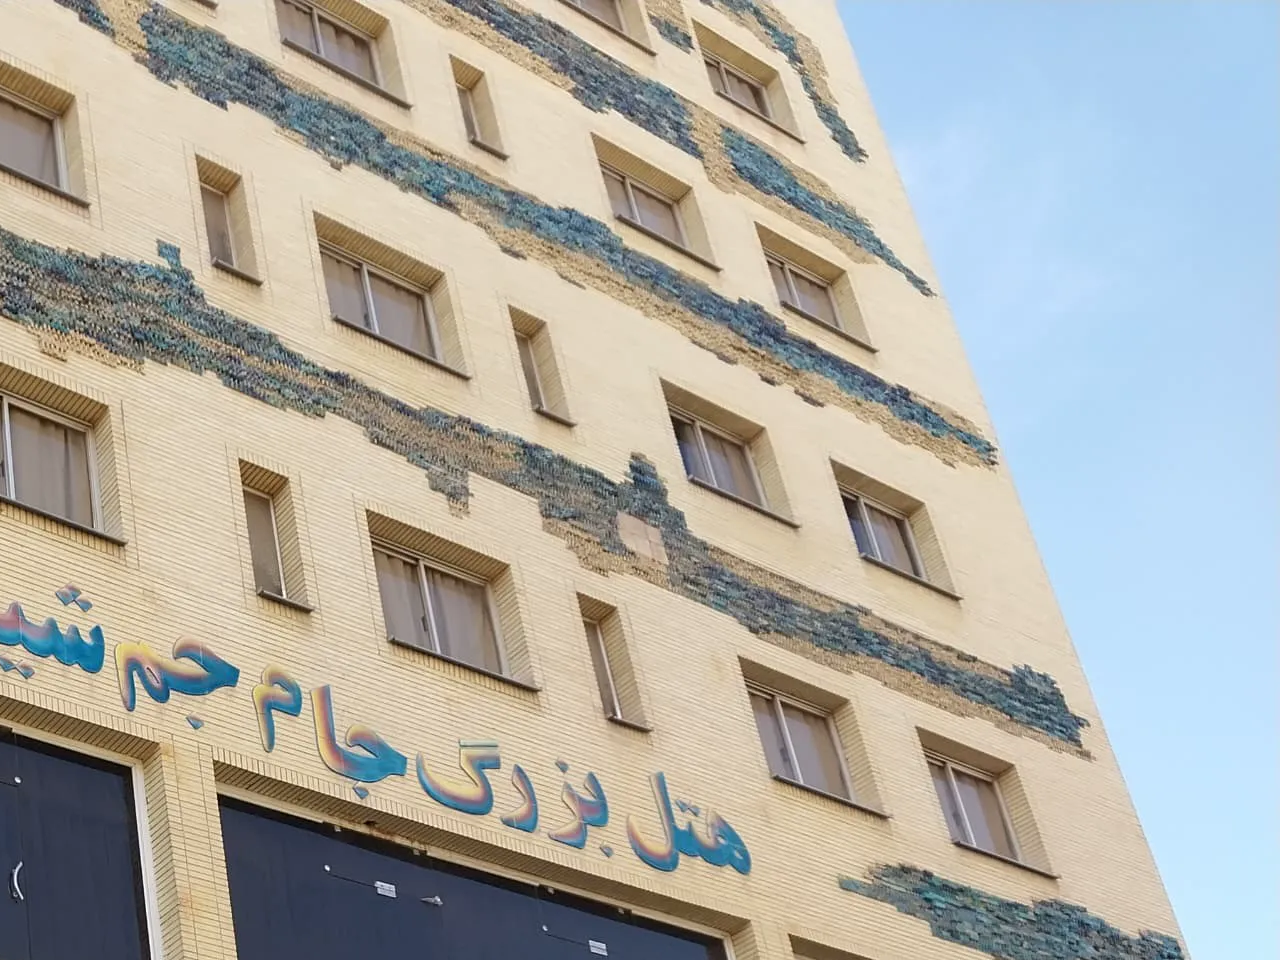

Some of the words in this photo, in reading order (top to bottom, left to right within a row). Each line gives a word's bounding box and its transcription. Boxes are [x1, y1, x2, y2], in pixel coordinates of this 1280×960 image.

[115, 634, 241, 730] جم
[252, 663, 408, 799] جام
[415, 739, 609, 858] بزرگ
[627, 770, 752, 875] هتل
